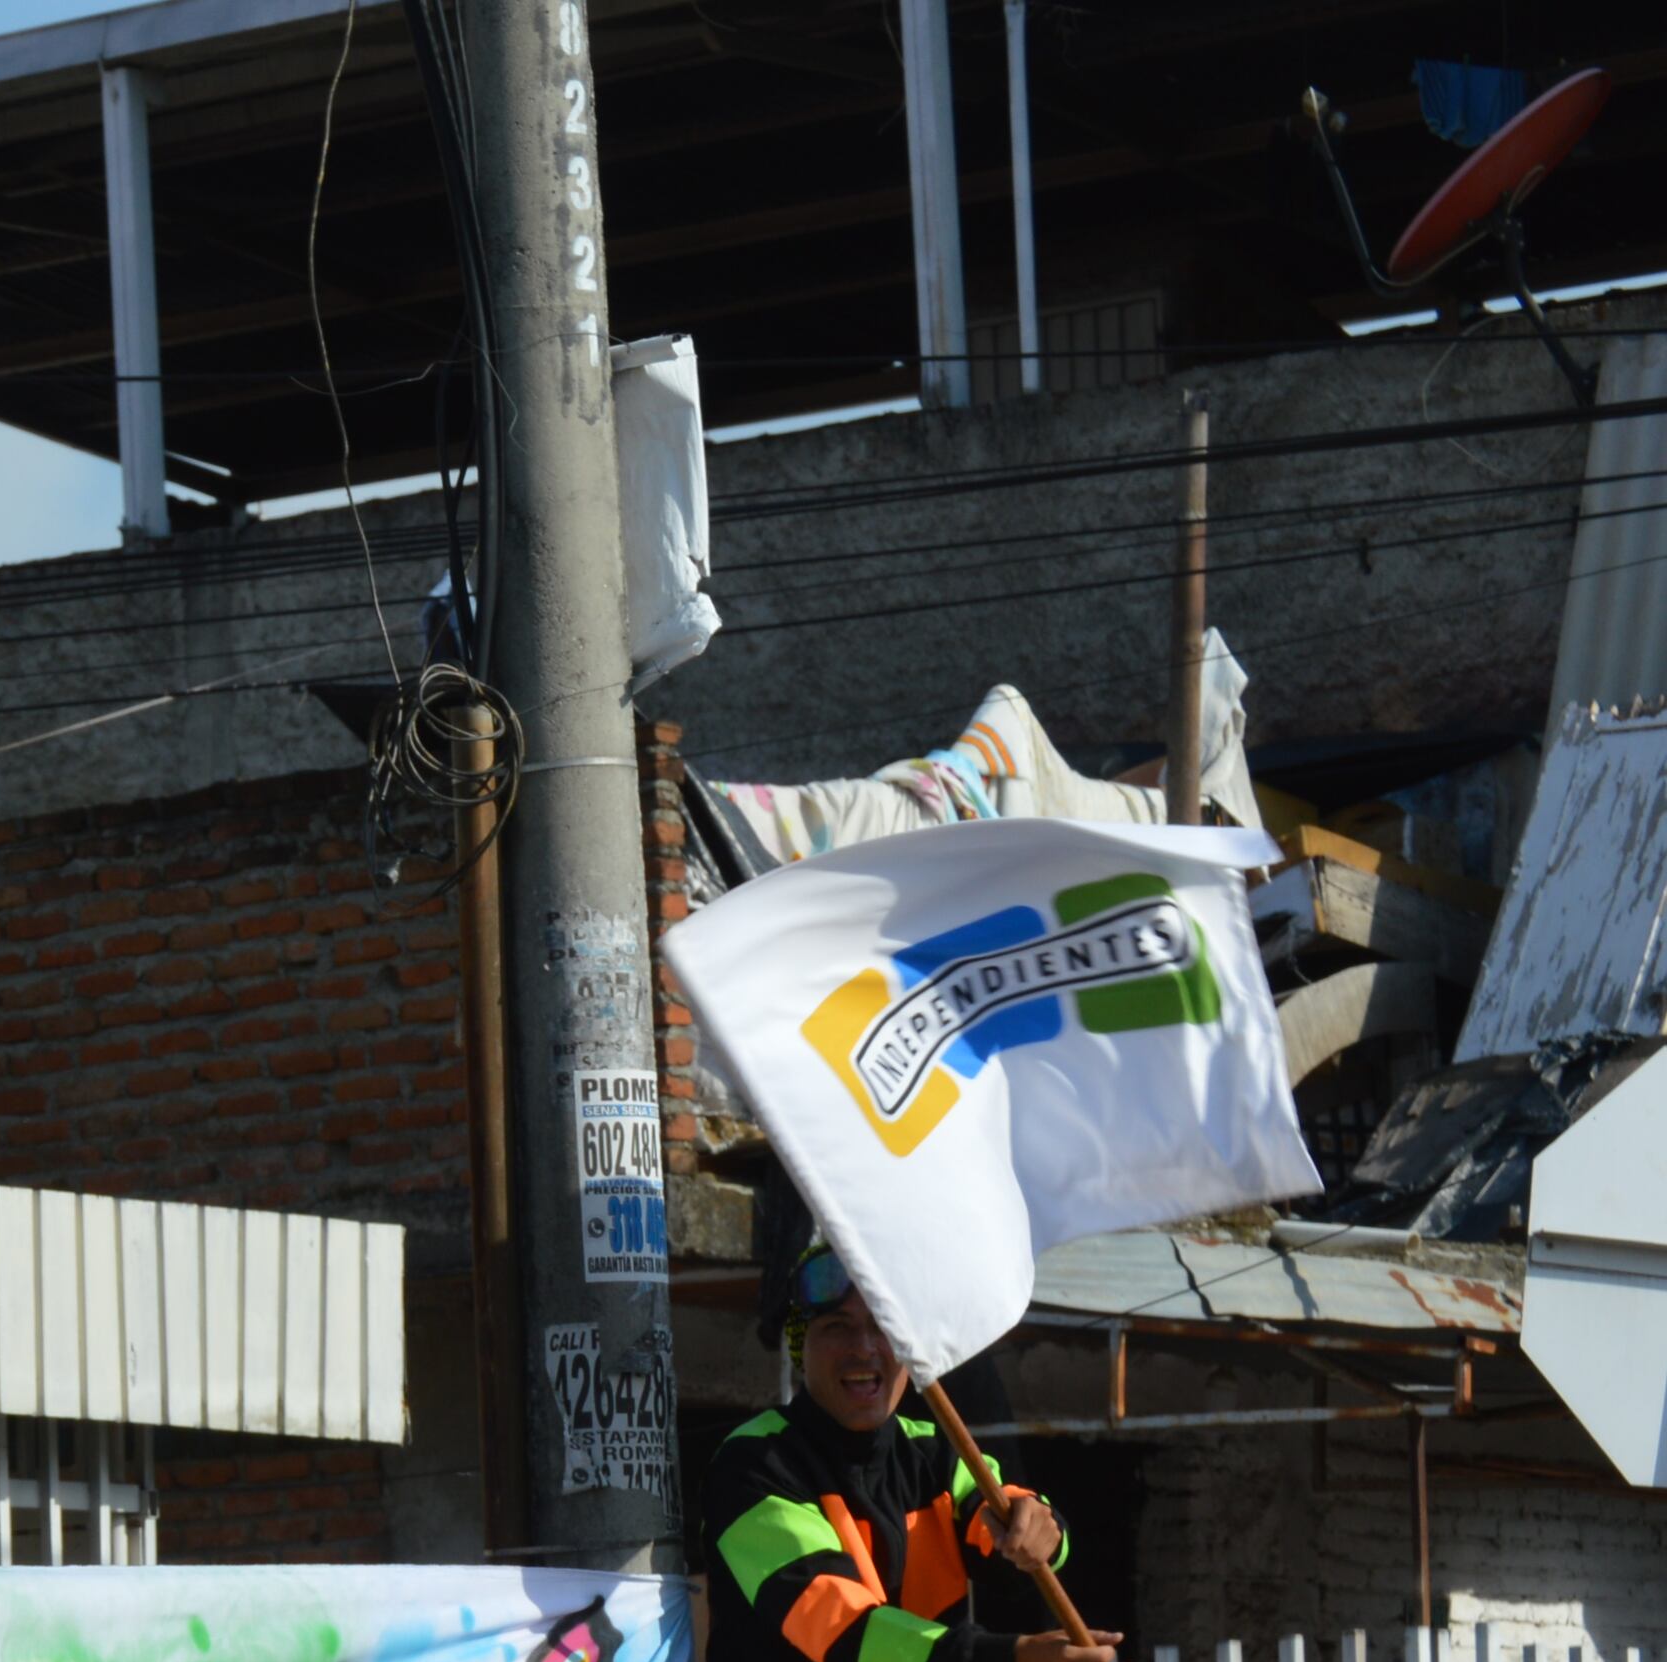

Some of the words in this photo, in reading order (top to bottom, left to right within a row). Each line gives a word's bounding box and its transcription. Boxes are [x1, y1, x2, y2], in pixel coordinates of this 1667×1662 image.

[870, 918, 1173, 1095] INDEPENDIENTES
[583, 1121, 626, 1177] 602
[550, 1331, 585, 1351] CALI
